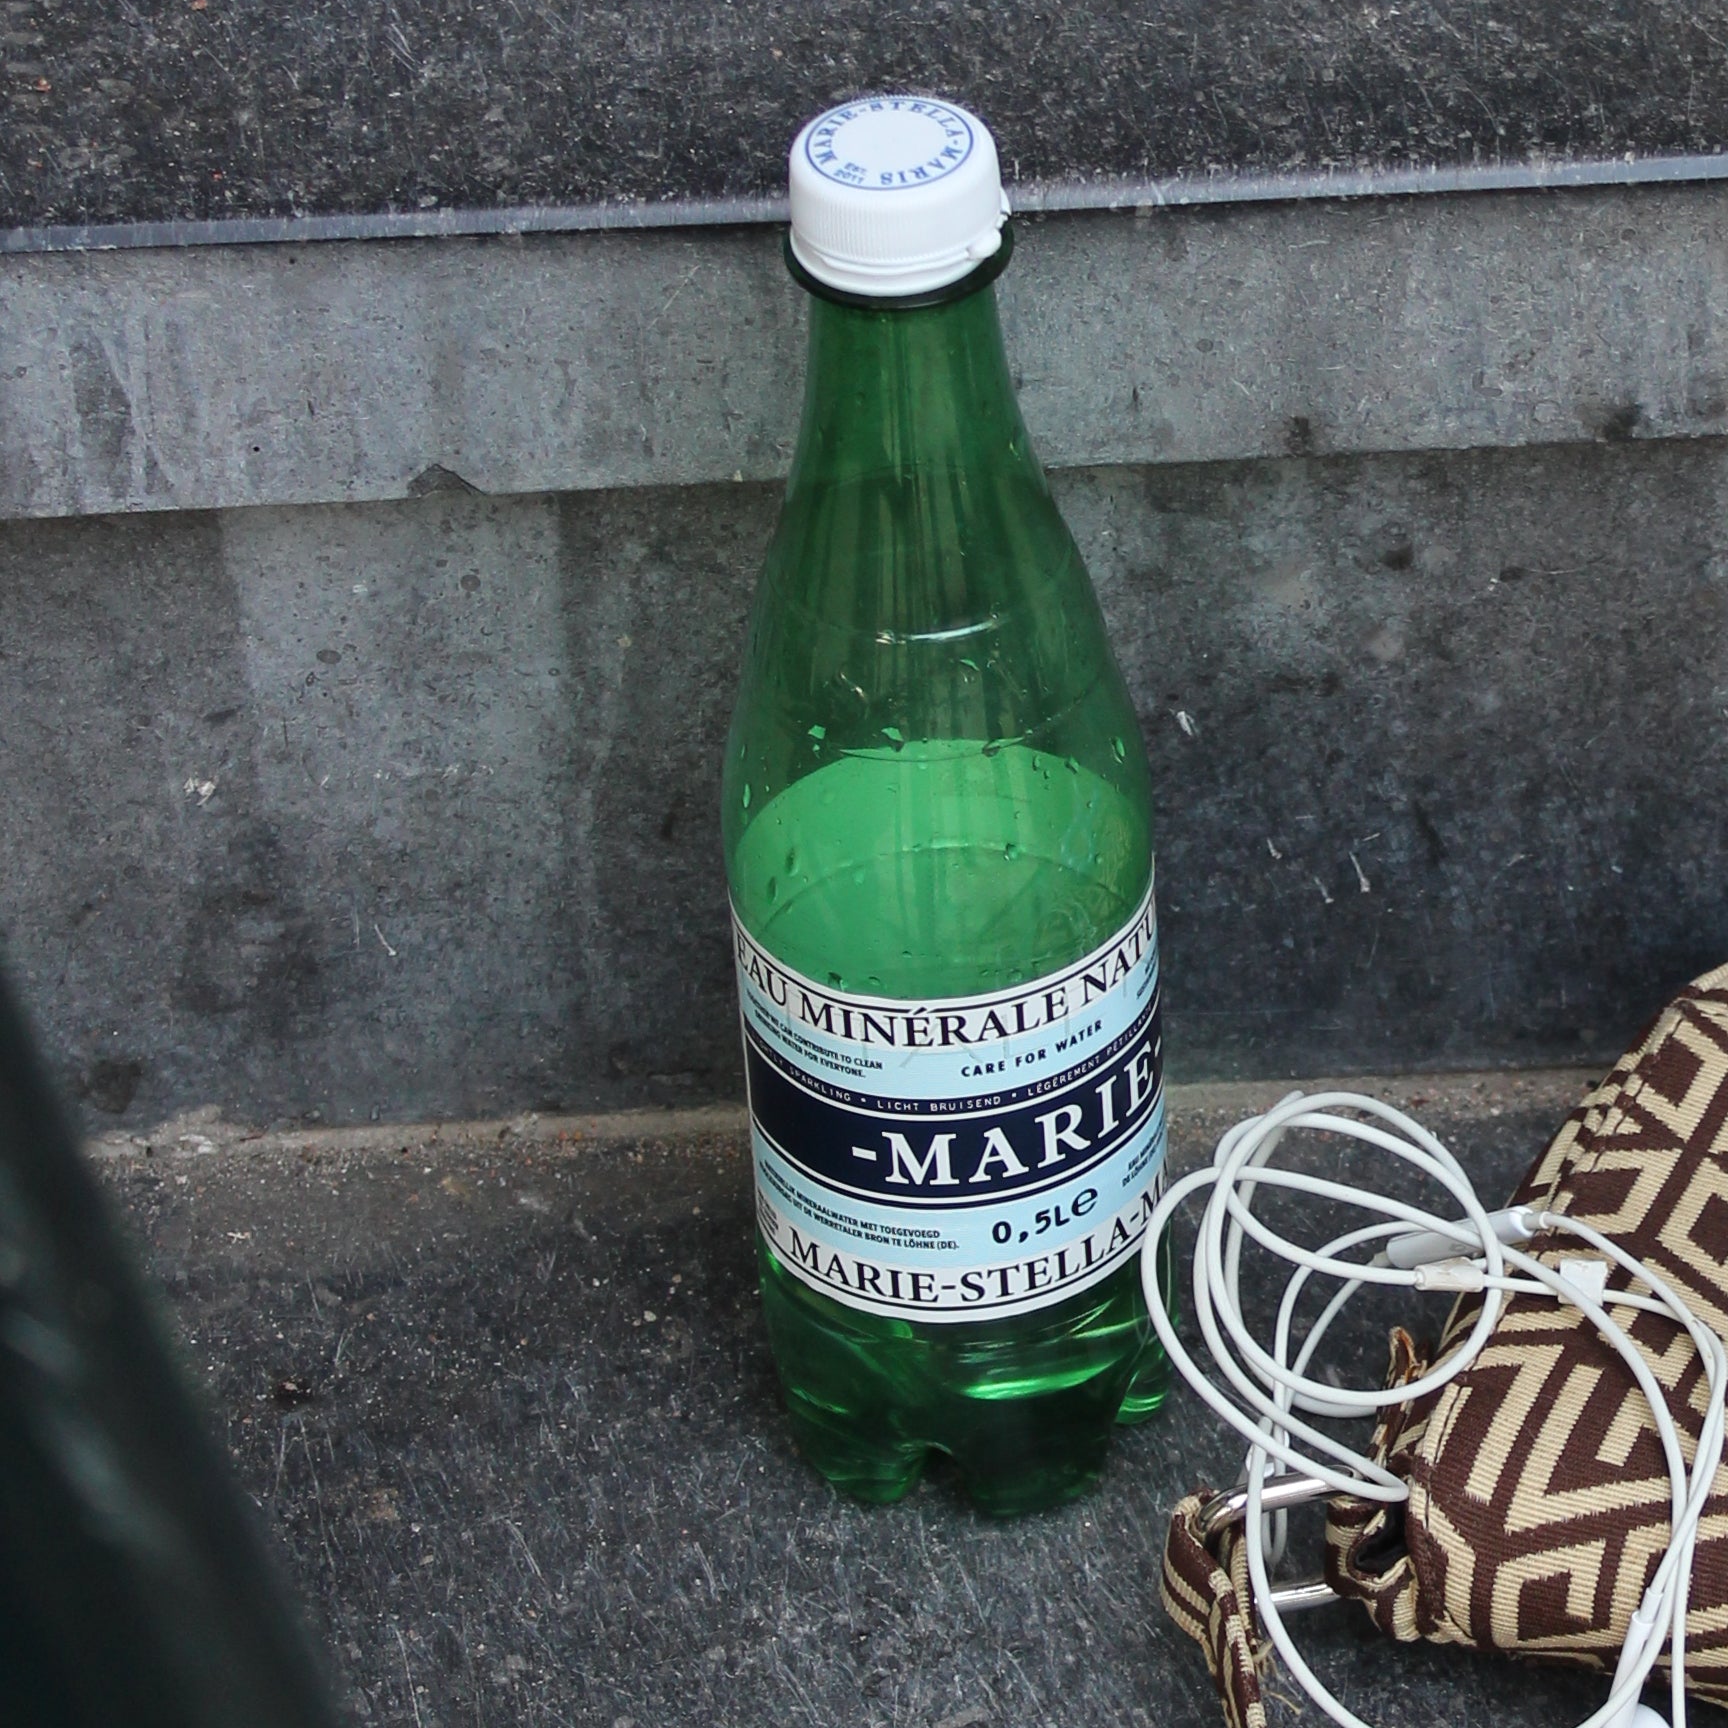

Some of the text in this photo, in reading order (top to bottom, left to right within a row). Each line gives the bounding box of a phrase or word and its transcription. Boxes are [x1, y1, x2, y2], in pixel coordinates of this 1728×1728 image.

[833, 169, 866, 184] 2011
[737, 932, 788, 1006] EAU
[798, 986, 1069, 1047] MINÉRALE
[793, 1033, 838, 1061] CONTRIBUTE
[840, 1054, 852, 1064] TO
[854, 1057, 883, 1070] CLEAN
[805, 1049, 818, 1063] FOR
[961, 1020, 1103, 1077] CARE FOR WATER
[789, 1067, 852, 1101] SPARKLING
[877, 1100, 919, 1111] LICHT
[930, 1096, 1002, 1112] BRUISEND
[797, 1190, 940, 1239] MINERAALWATER MET TOEGEVOEGD
[813, 1213, 863, 1240] WERRETALER
[865, 1233, 889, 1245] BRON
[891, 1237, 901, 1248] TE
